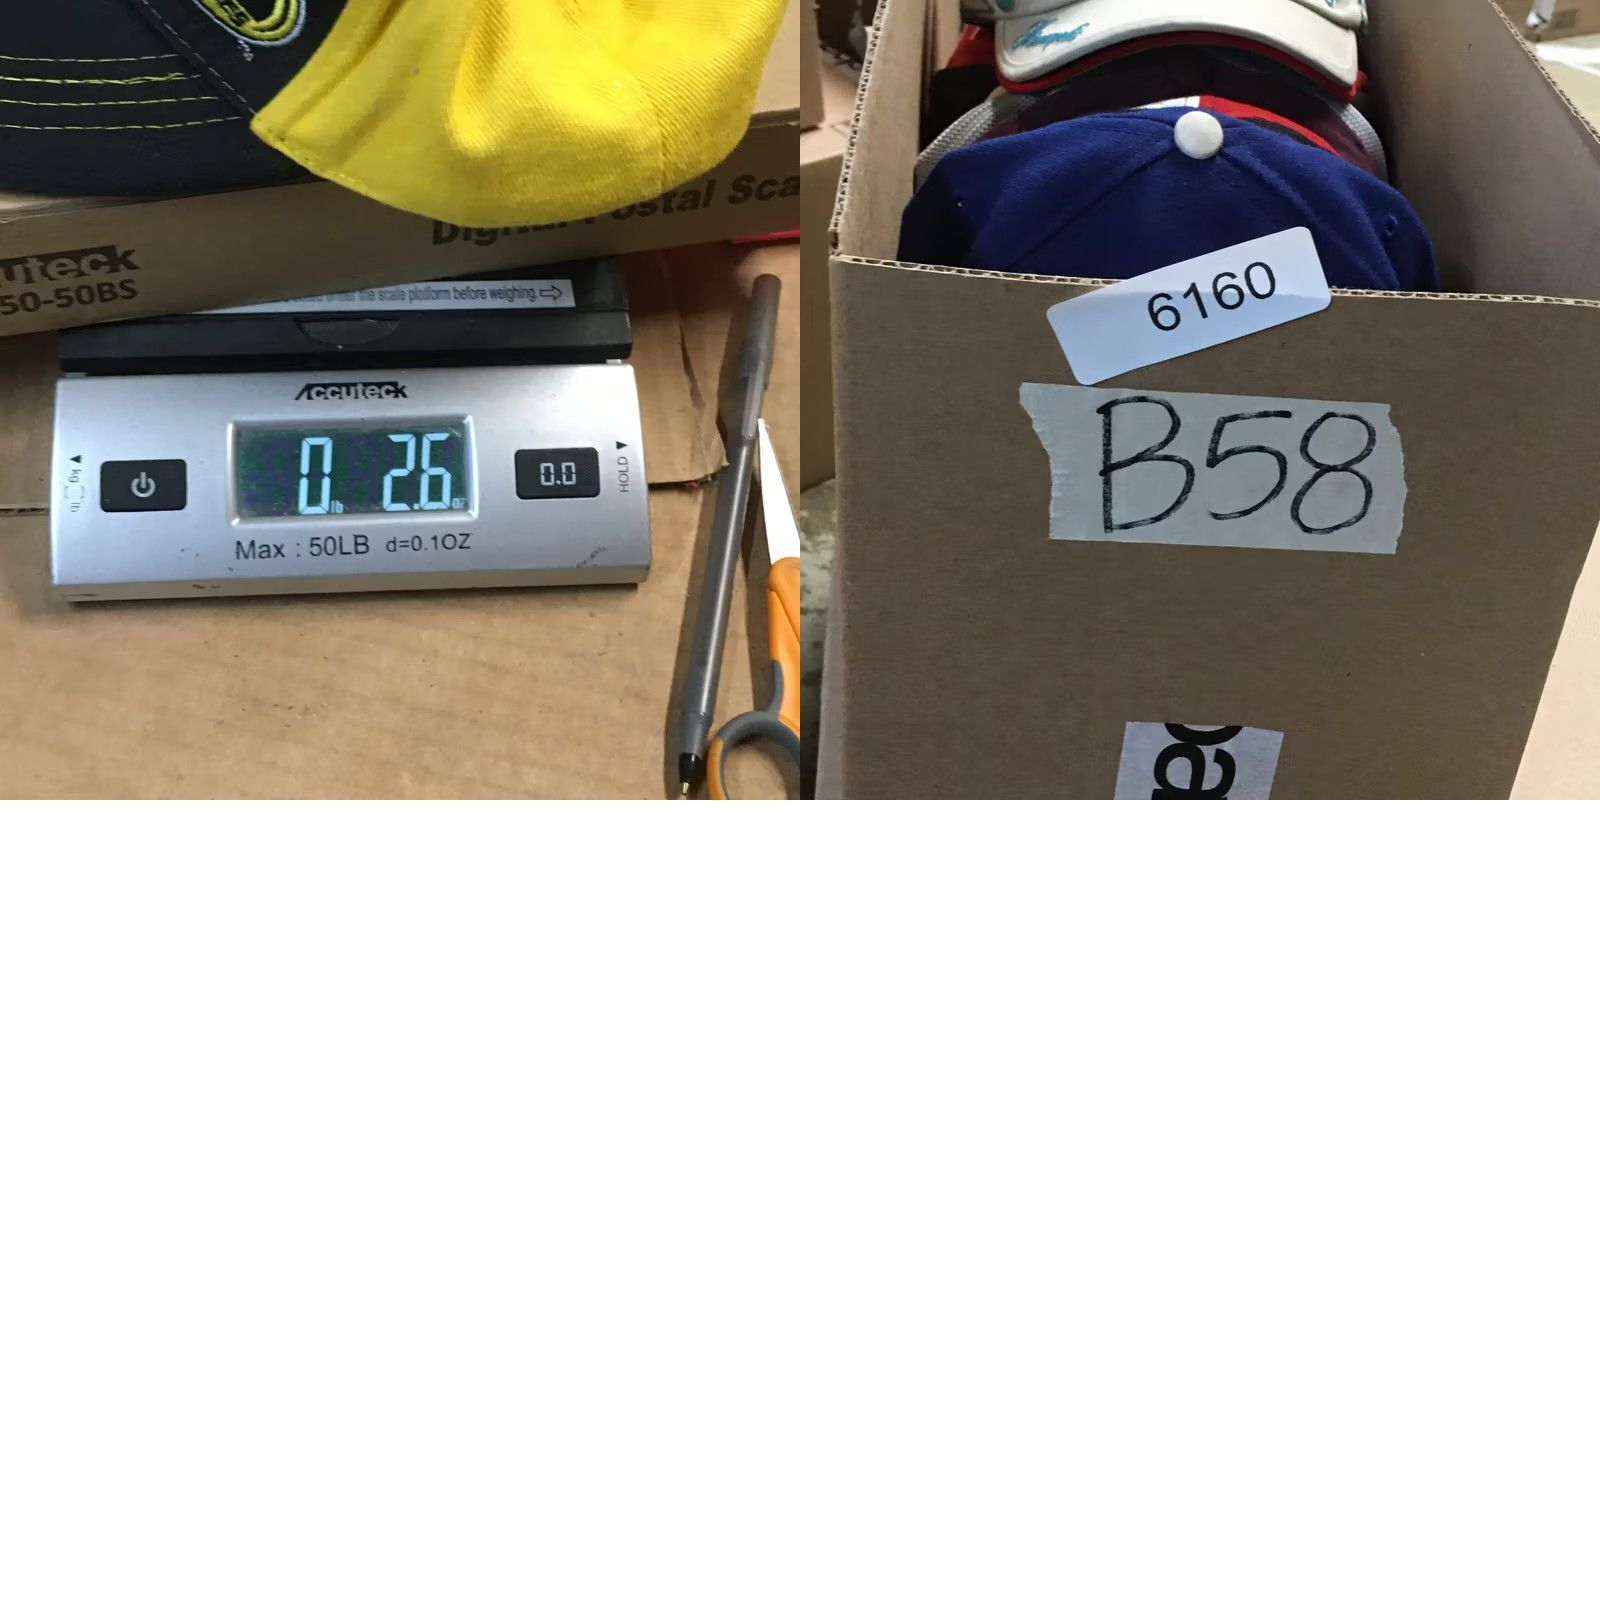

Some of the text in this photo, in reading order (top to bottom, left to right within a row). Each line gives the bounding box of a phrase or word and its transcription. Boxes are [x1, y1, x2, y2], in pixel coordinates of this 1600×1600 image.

[585, 179, 717, 225] ostal
[452, 286, 487, 301] before
[1147, 260, 1277, 332] 6160
[294, 381, 409, 400] Accuteck
[540, 461, 577, 486] 0.0
[617, 456, 630, 493] HOLD
[1096, 394, 1377, 535] B58
[235, 540, 286, 561] Max
[309, 534, 370, 557] 50LB
